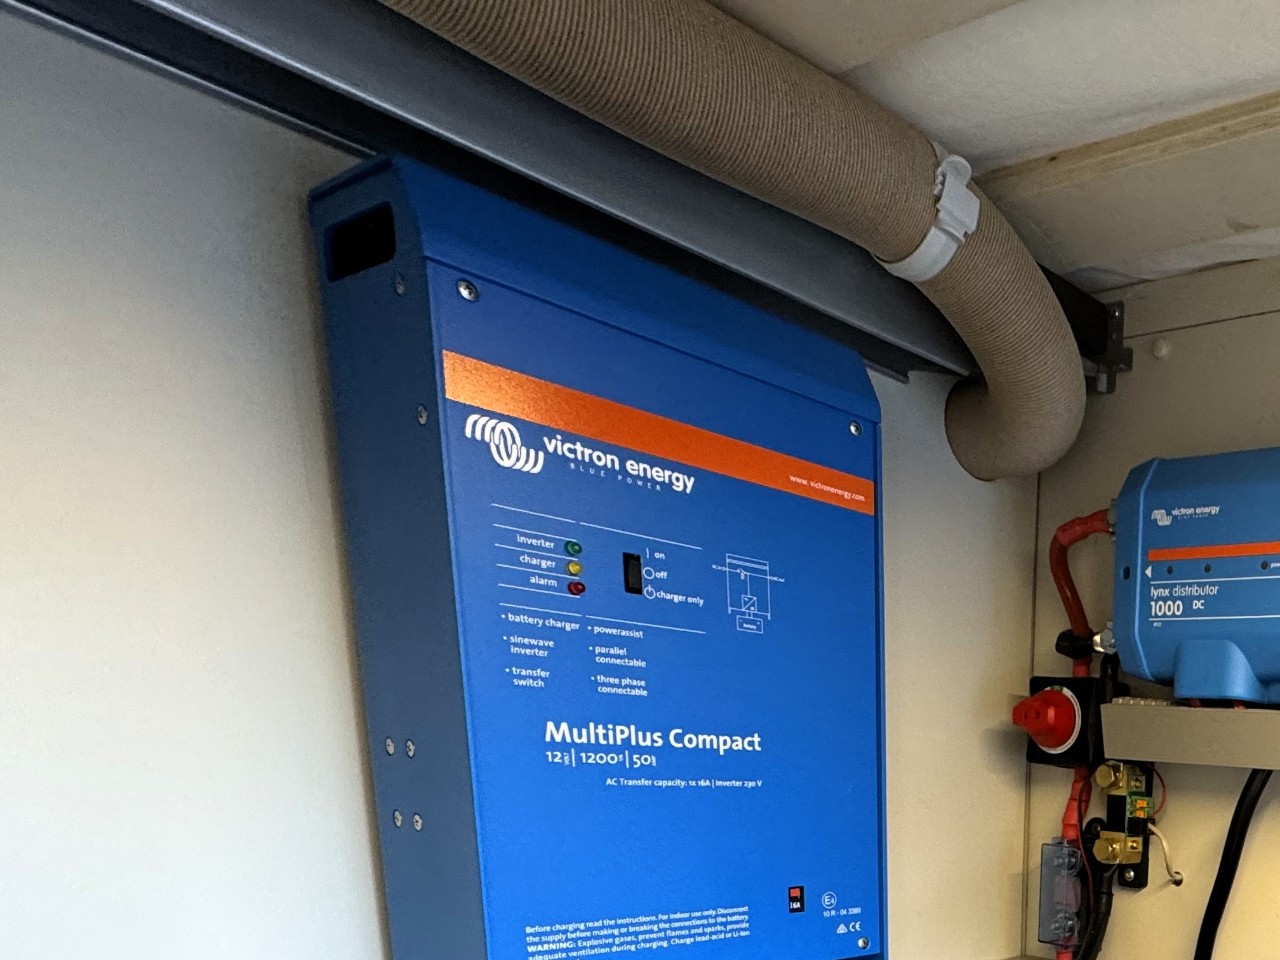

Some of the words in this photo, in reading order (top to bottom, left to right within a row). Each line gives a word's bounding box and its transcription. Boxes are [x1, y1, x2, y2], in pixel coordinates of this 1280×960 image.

[543, 434, 619, 470] victron
[625, 457, 695, 494] energy
[569, 463, 606, 477] BLUE
[617, 475, 661, 491] POWER
[1171, 507, 1194, 516] victron
[1195, 506, 1220, 514] energy
[516, 533, 555, 549] inverter
[520, 554, 556, 569] charger
[655, 551, 665, 559] on
[529, 575, 557, 587] alarm
[655, 570, 668, 579] off
[656, 591, 686, 604] charger
[688, 594, 704, 607] only
[1150, 586, 1170, 600] lynx
[1172, 584, 1219, 597] distributor
[1150, 600, 1183, 617] 1000
[1192, 600, 1205, 609] DC
[508, 612, 543, 627] battery
[545, 618, 580, 632] charger
[593, 625, 644, 639] powerassist
[509, 635, 555, 648] sinewave
[510, 645, 548, 657] inverter
[595, 645, 627, 656] parallel
[595, 654, 647, 668] connectable
[512, 665, 550, 678] transfer
[513, 676, 545, 688] switch
[597, 674, 620, 685] three
[621, 676, 646, 687] phase
[597, 684, 648, 696] connectable
[545, 721, 663, 747] MultiPlus
[669, 728, 761, 755] Compact
[546, 751, 562, 763] 12
[579, 753, 618, 764] 1200
[633, 754, 651, 768] 50
[605, 777, 617, 786] AC
[619, 777, 652, 787] Transfer
[654, 779, 687, 789] capacity:
[715, 779, 743, 788] Inverter
[744, 780, 756, 789] 230
[790, 901, 801, 909] 16A
[525, 925, 551, 934] Before
[552, 922, 585, 932] charging
[586, 920, 602, 928] read
[669, 912, 690, 920] indoor
[717, 906, 749, 915] Disconnect
[526, 936, 540, 944] the
[541, 932, 567, 942] supply
[567, 930, 591, 940] before
[592, 927, 619, 936] making
[628, 923, 659, 932] breaking
[659, 921, 670, 929] the
[671, 919, 708, 928] connections
[527, 941, 576, 952] WARNING:
[577, 938, 613, 947] Explosive
[638, 931, 665, 942] prevent
[666, 929, 689, 938] flames
[690, 926, 703, 934] and
[726, 922, 749, 931] provide
[568, 947, 610, 957] ventilation
[611, 943, 636, 952] during
[670, 937, 694, 946] Charge
[695, 931, 725, 942] lead-acid
